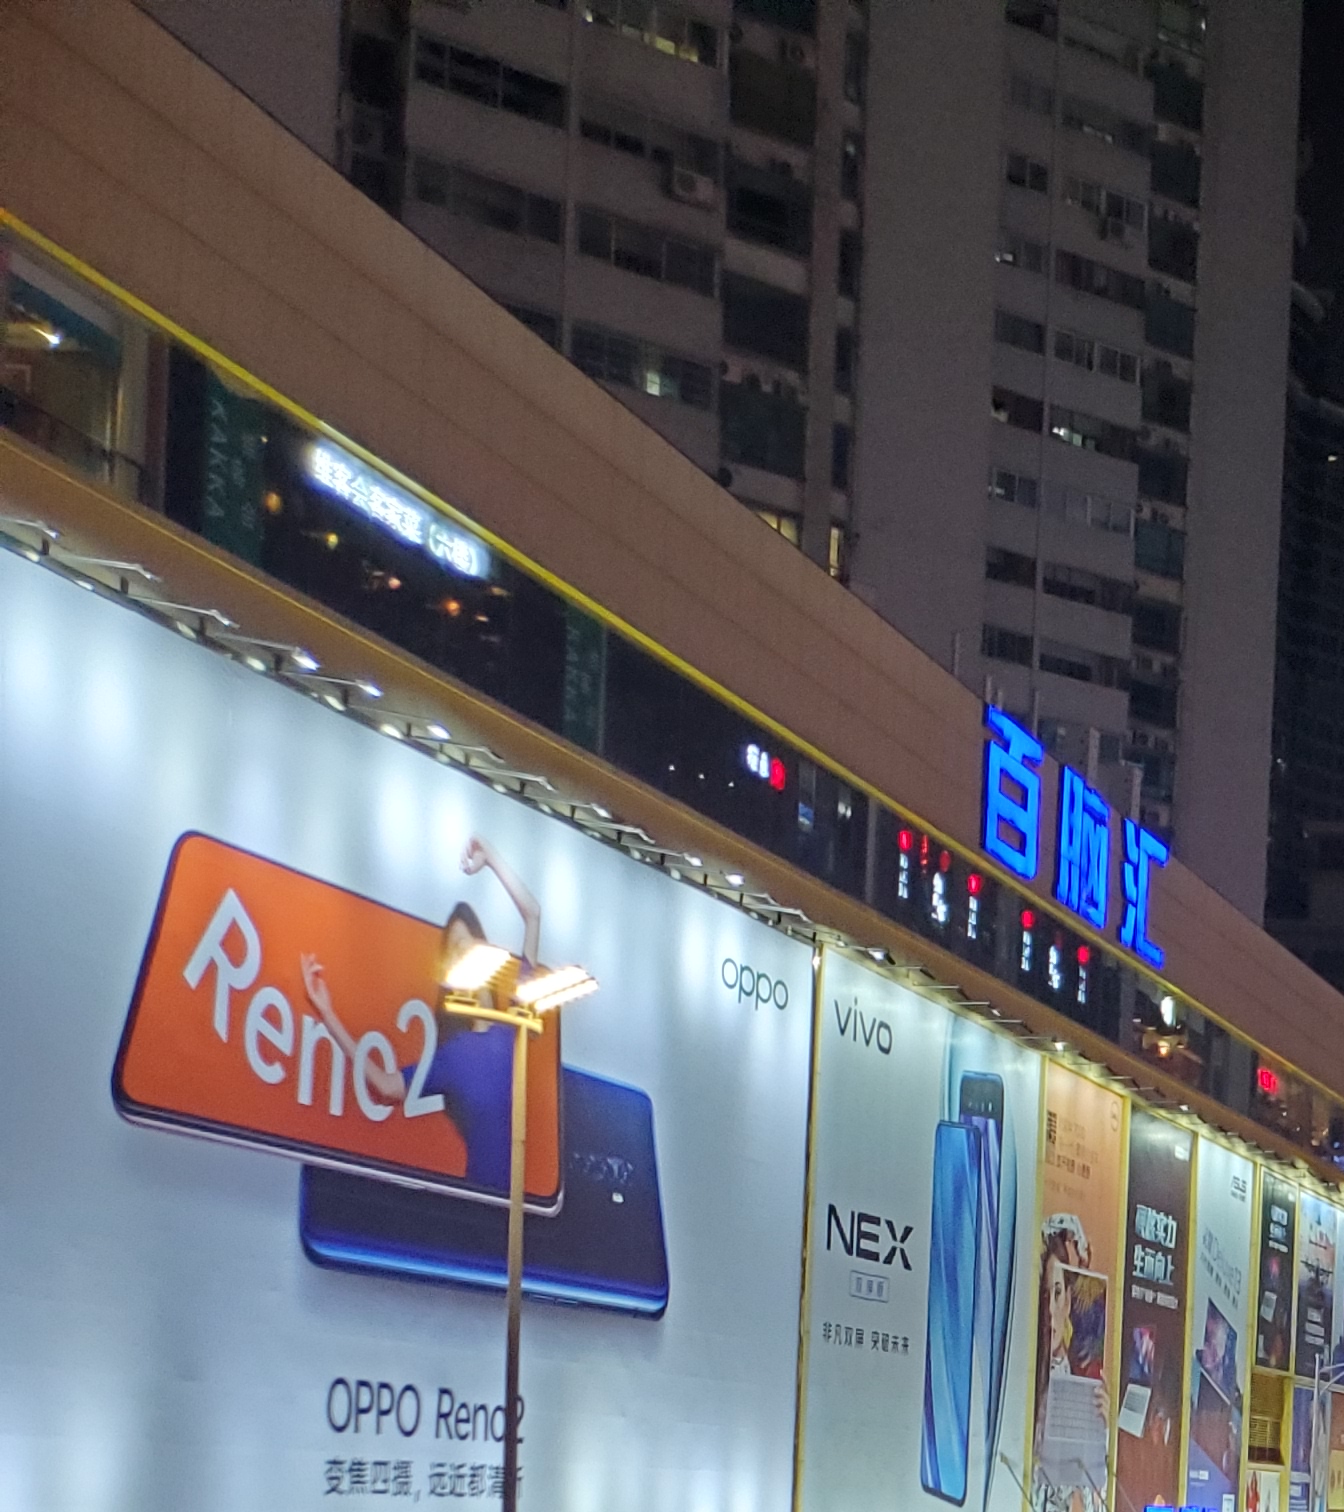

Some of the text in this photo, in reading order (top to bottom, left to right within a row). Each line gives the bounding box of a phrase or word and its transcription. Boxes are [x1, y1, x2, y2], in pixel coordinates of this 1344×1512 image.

[983, 702, 1170, 970] 百脑汇
[834, 997, 893, 1055] vivo
[826, 1203, 914, 1271] NEX
[326, 1377, 421, 1437] OPPO
